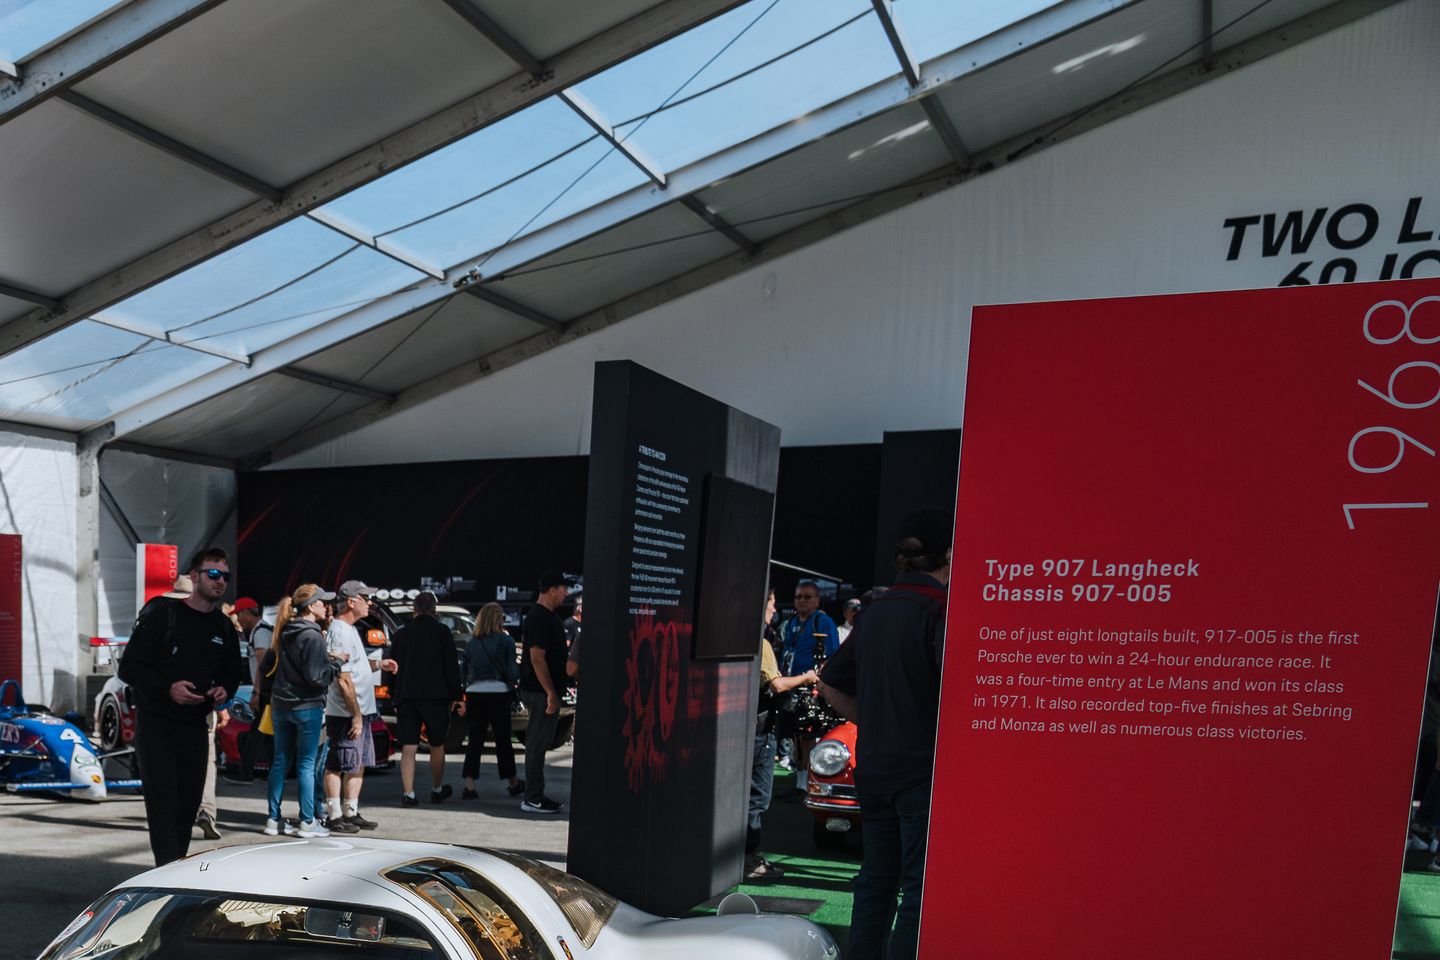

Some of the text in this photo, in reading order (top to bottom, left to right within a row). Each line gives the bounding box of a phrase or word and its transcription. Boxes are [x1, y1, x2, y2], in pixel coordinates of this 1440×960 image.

[1222, 196, 1440, 262] TWO L
[1342, 294, 1440, 531] 1968
[985, 558, 1200, 582] Type 907 Langheck
[982, 584, 1171, 602] Chassis 907-005
[979, 626, 1360, 645] One of just eight longtails built, 917-005 is the first
[978, 650, 1332, 669] Porsche ever to win a 24-hour endurance race. It
[975, 673, 1344, 693] was a four-time entry at Le Mans and won its class
[973, 695, 1353, 721] in 1971. It also recorded top-five finishes at Sebring
[60, 728, 84, 744] 4
[971, 718, 1307, 741] and Monza as well as numerous class victories.
